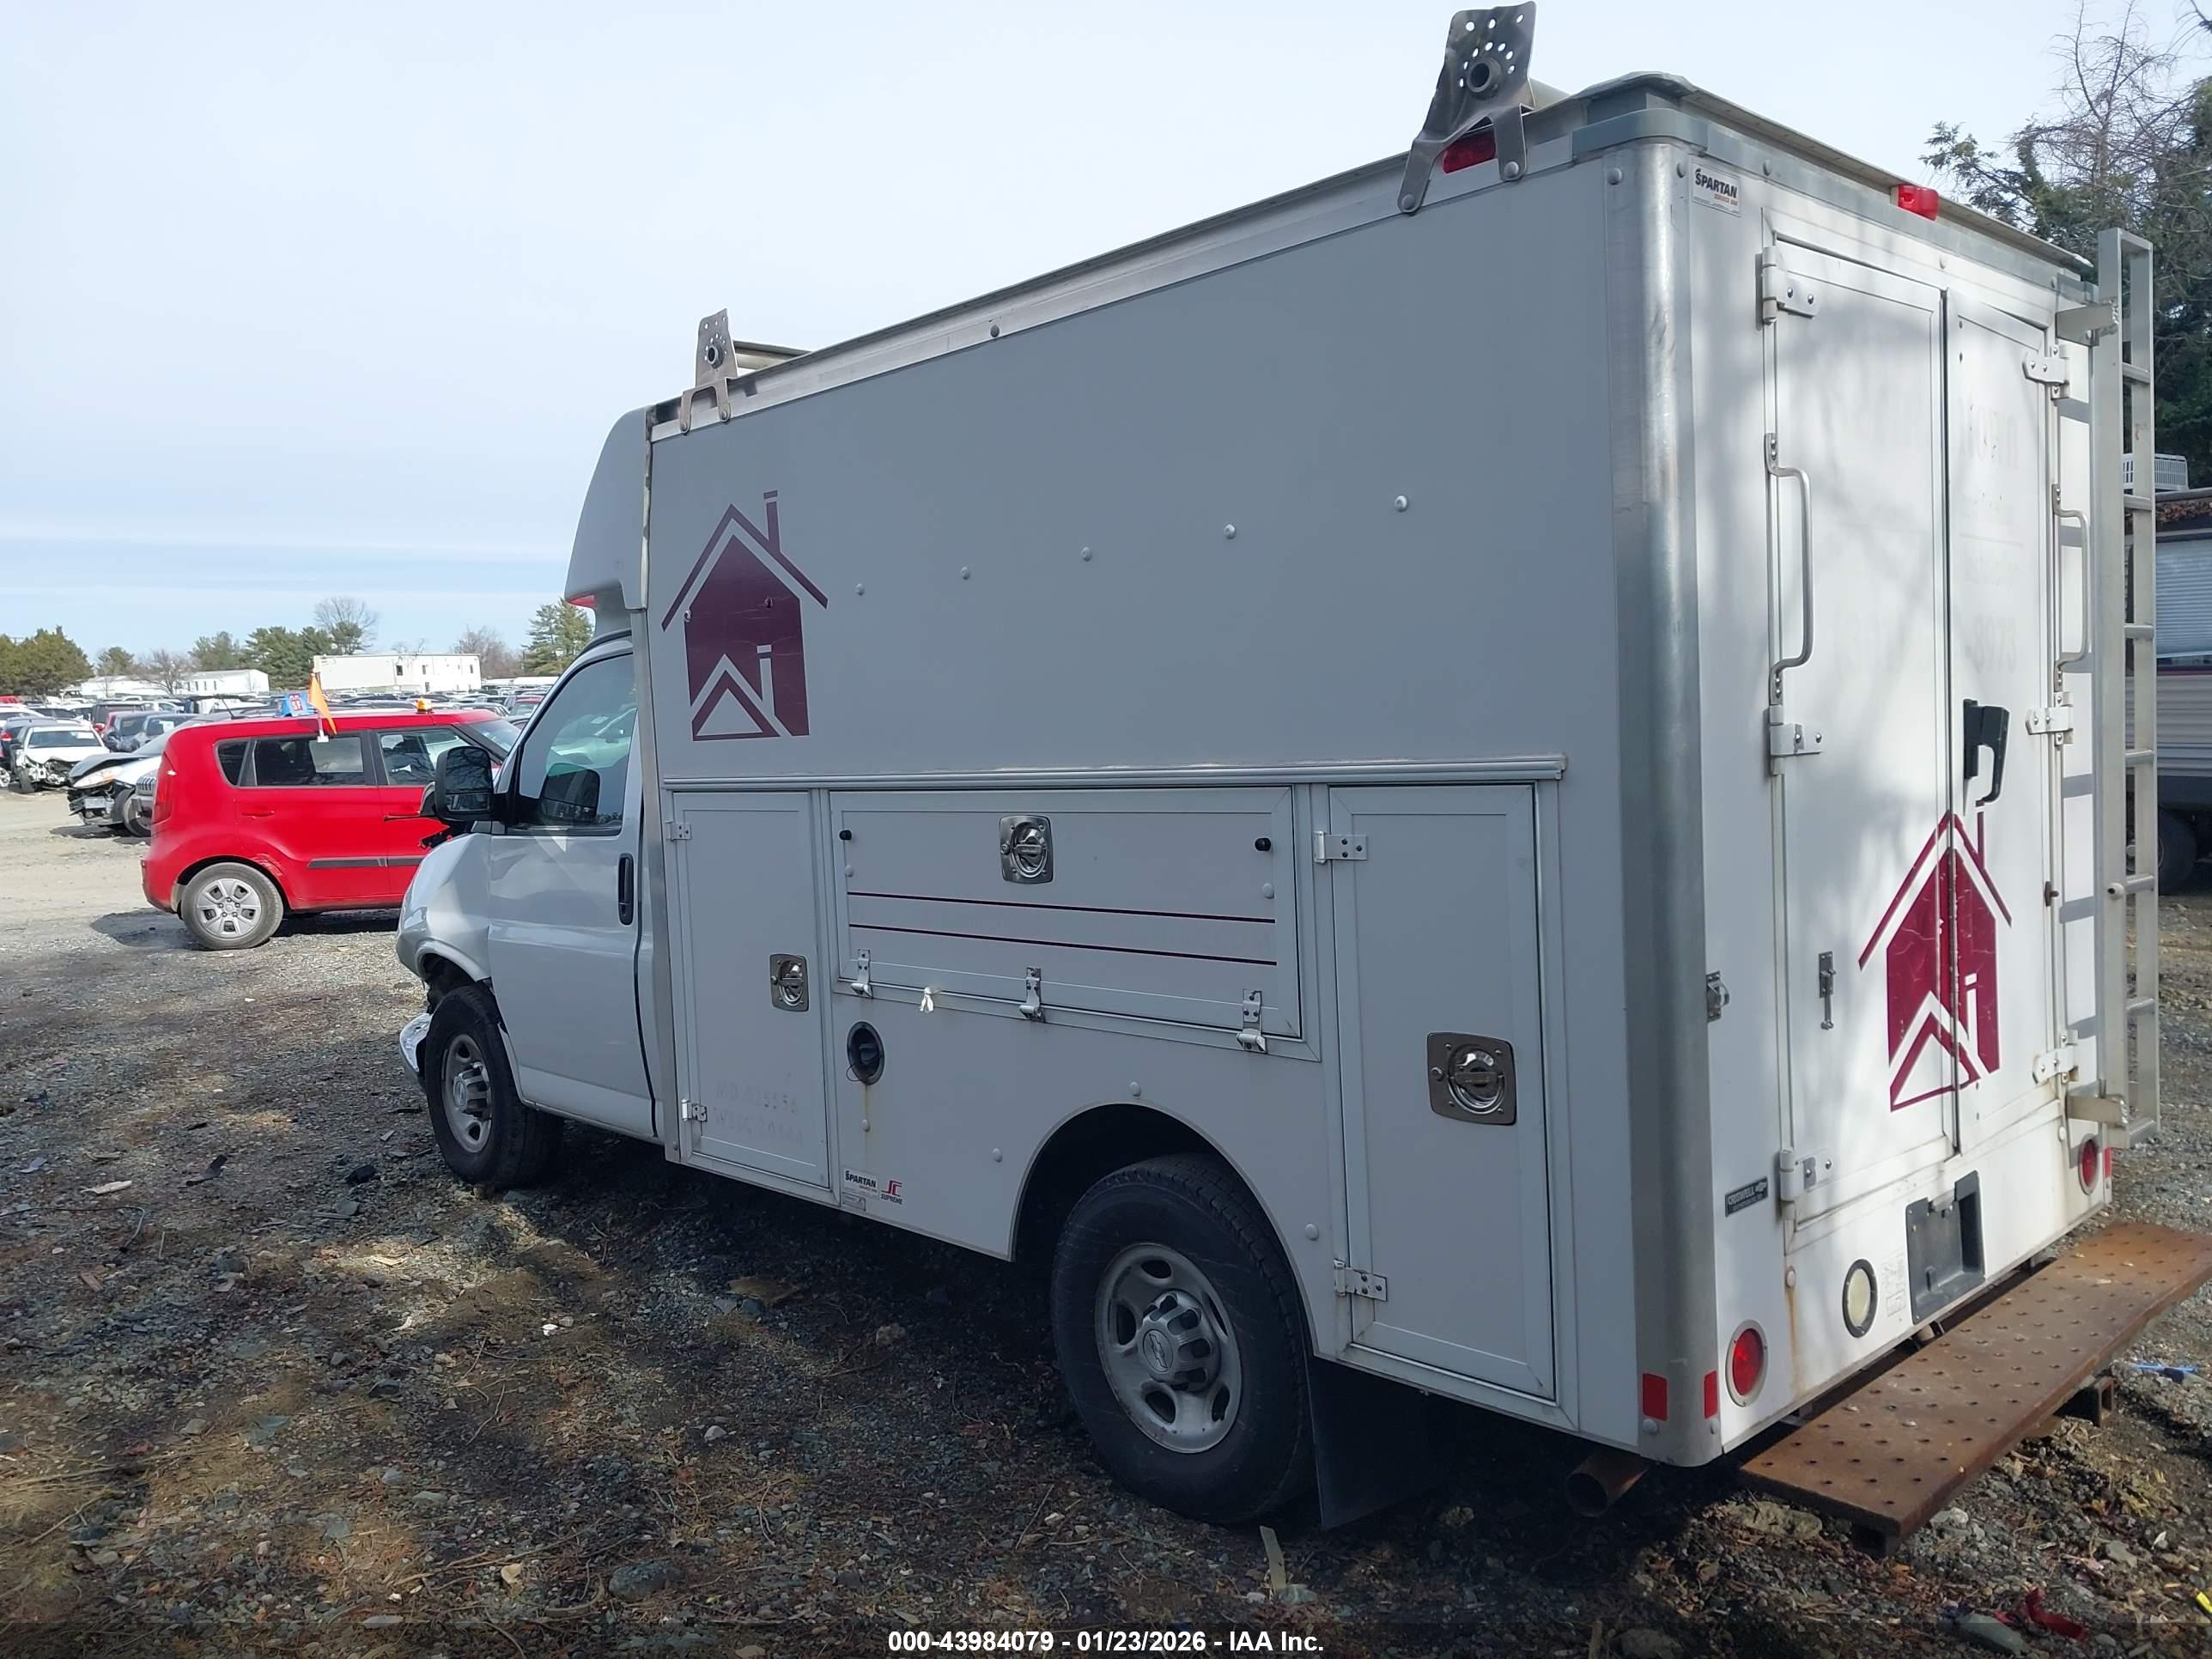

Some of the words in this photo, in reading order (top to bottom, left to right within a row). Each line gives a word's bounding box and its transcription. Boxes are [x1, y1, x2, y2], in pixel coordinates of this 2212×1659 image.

[1695, 168, 1738, 198] SPARTAN
[845, 1170, 877, 1188] SPARTAN
[881, 1193, 903, 1205] SUPREME
